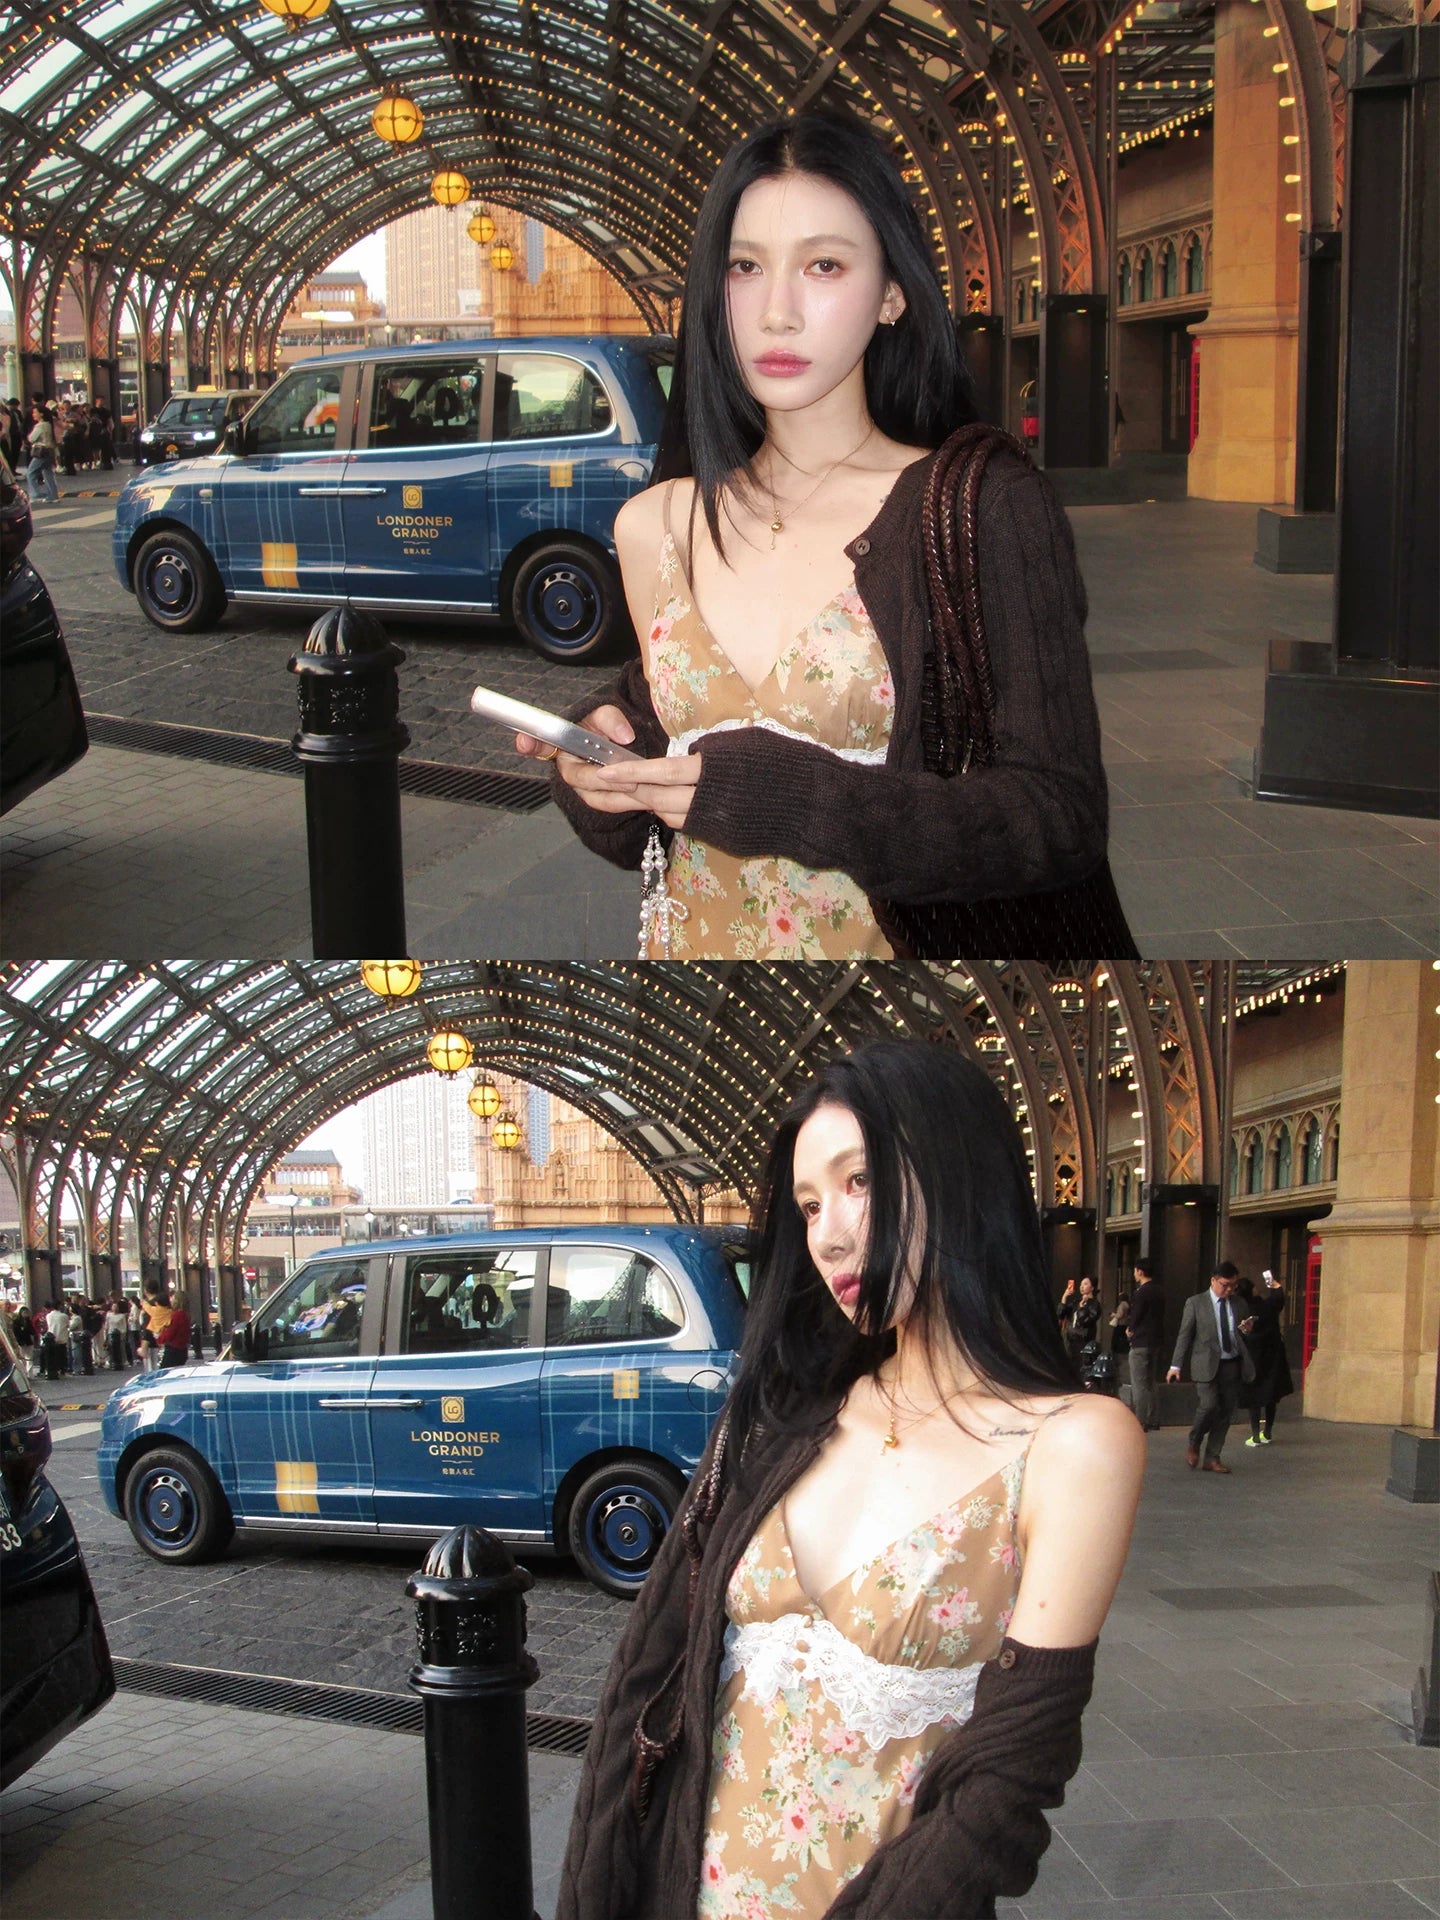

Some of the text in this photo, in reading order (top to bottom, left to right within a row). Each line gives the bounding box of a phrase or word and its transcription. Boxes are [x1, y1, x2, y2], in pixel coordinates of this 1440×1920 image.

[376, 515, 453, 527] LONDONER
[391, 527, 439, 539] GRAND
[447, 1405, 459, 1415] LG
[410, 1430, 500, 1443] LONDONER
[428, 1444, 484, 1457] GRAND
